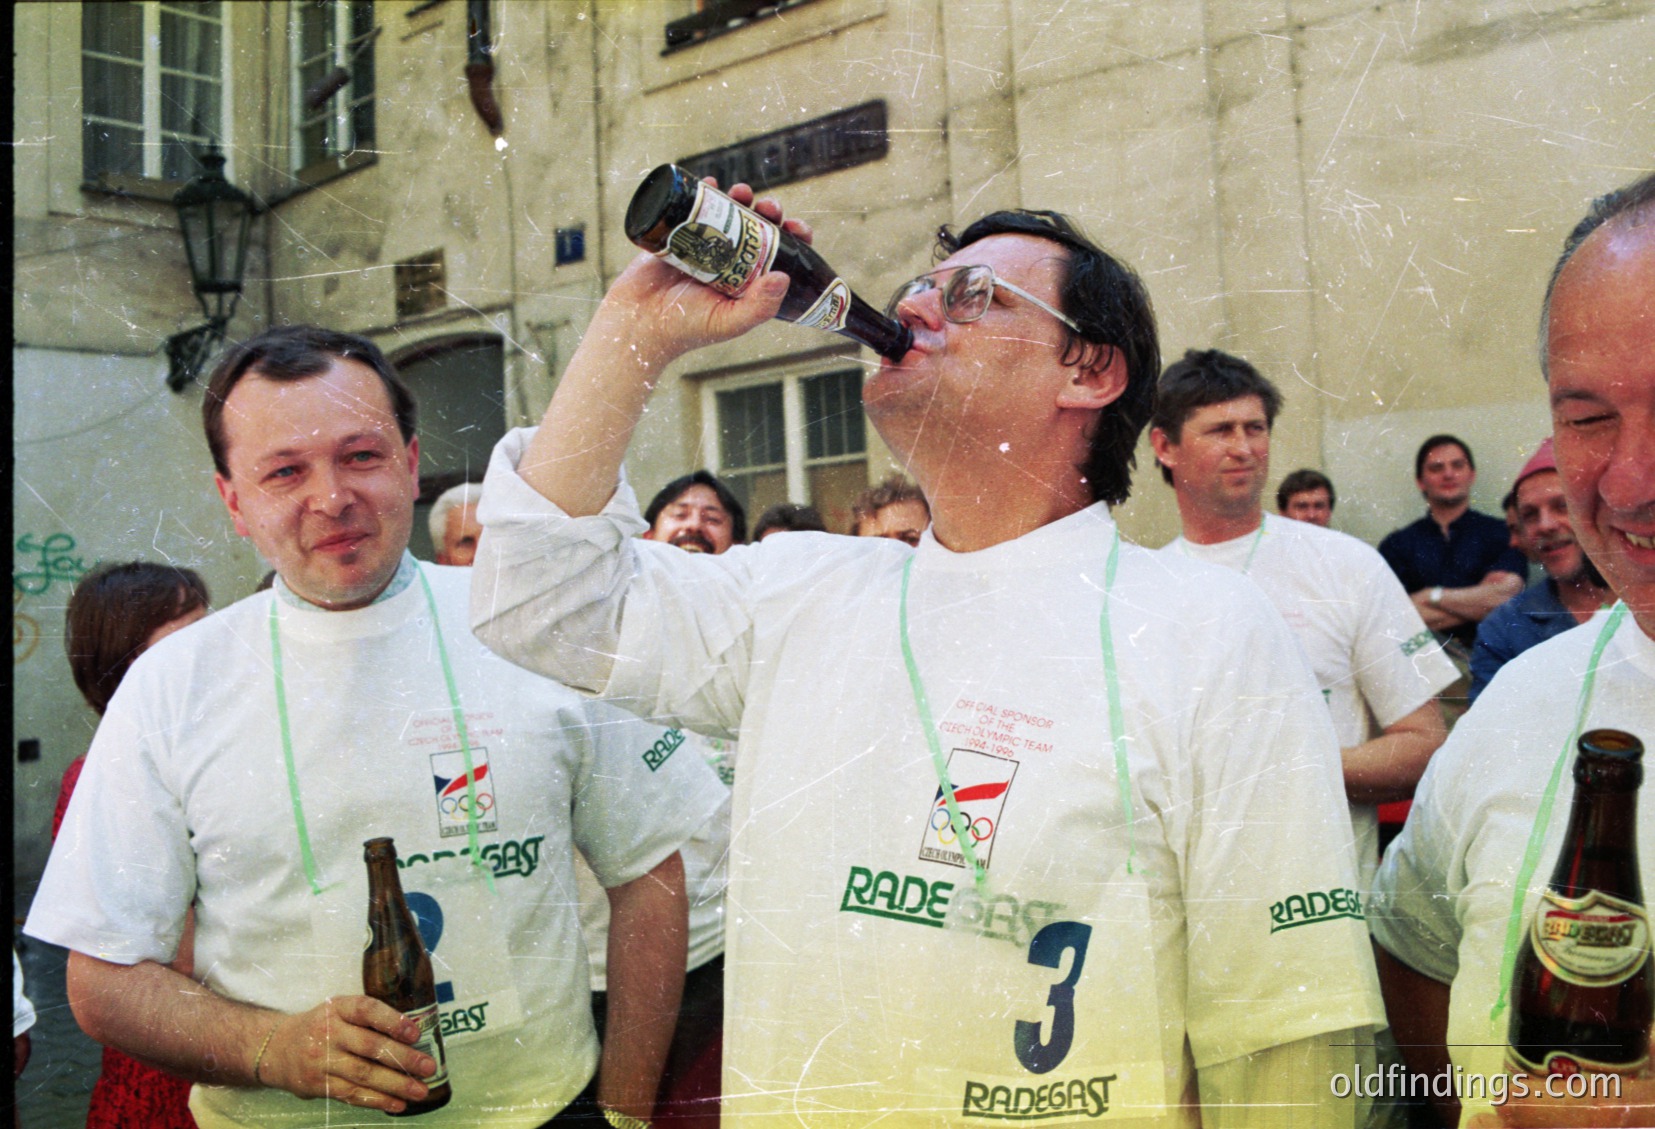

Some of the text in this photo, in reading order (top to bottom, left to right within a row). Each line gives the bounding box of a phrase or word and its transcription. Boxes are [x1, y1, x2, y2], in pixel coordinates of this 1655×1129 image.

[956, 699, 1054, 729] OFFCIAL SPONSOR
[979, 714, 1015, 732] OF THE
[965, 737, 1014, 758] 1994-1996
[972, 726, 1021, 747] OLYMPIC
[1023, 739, 1054, 753] TEAM
[1013, 920, 1093, 1075] 3
[962, 1073, 1118, 1120] RADEGAST
